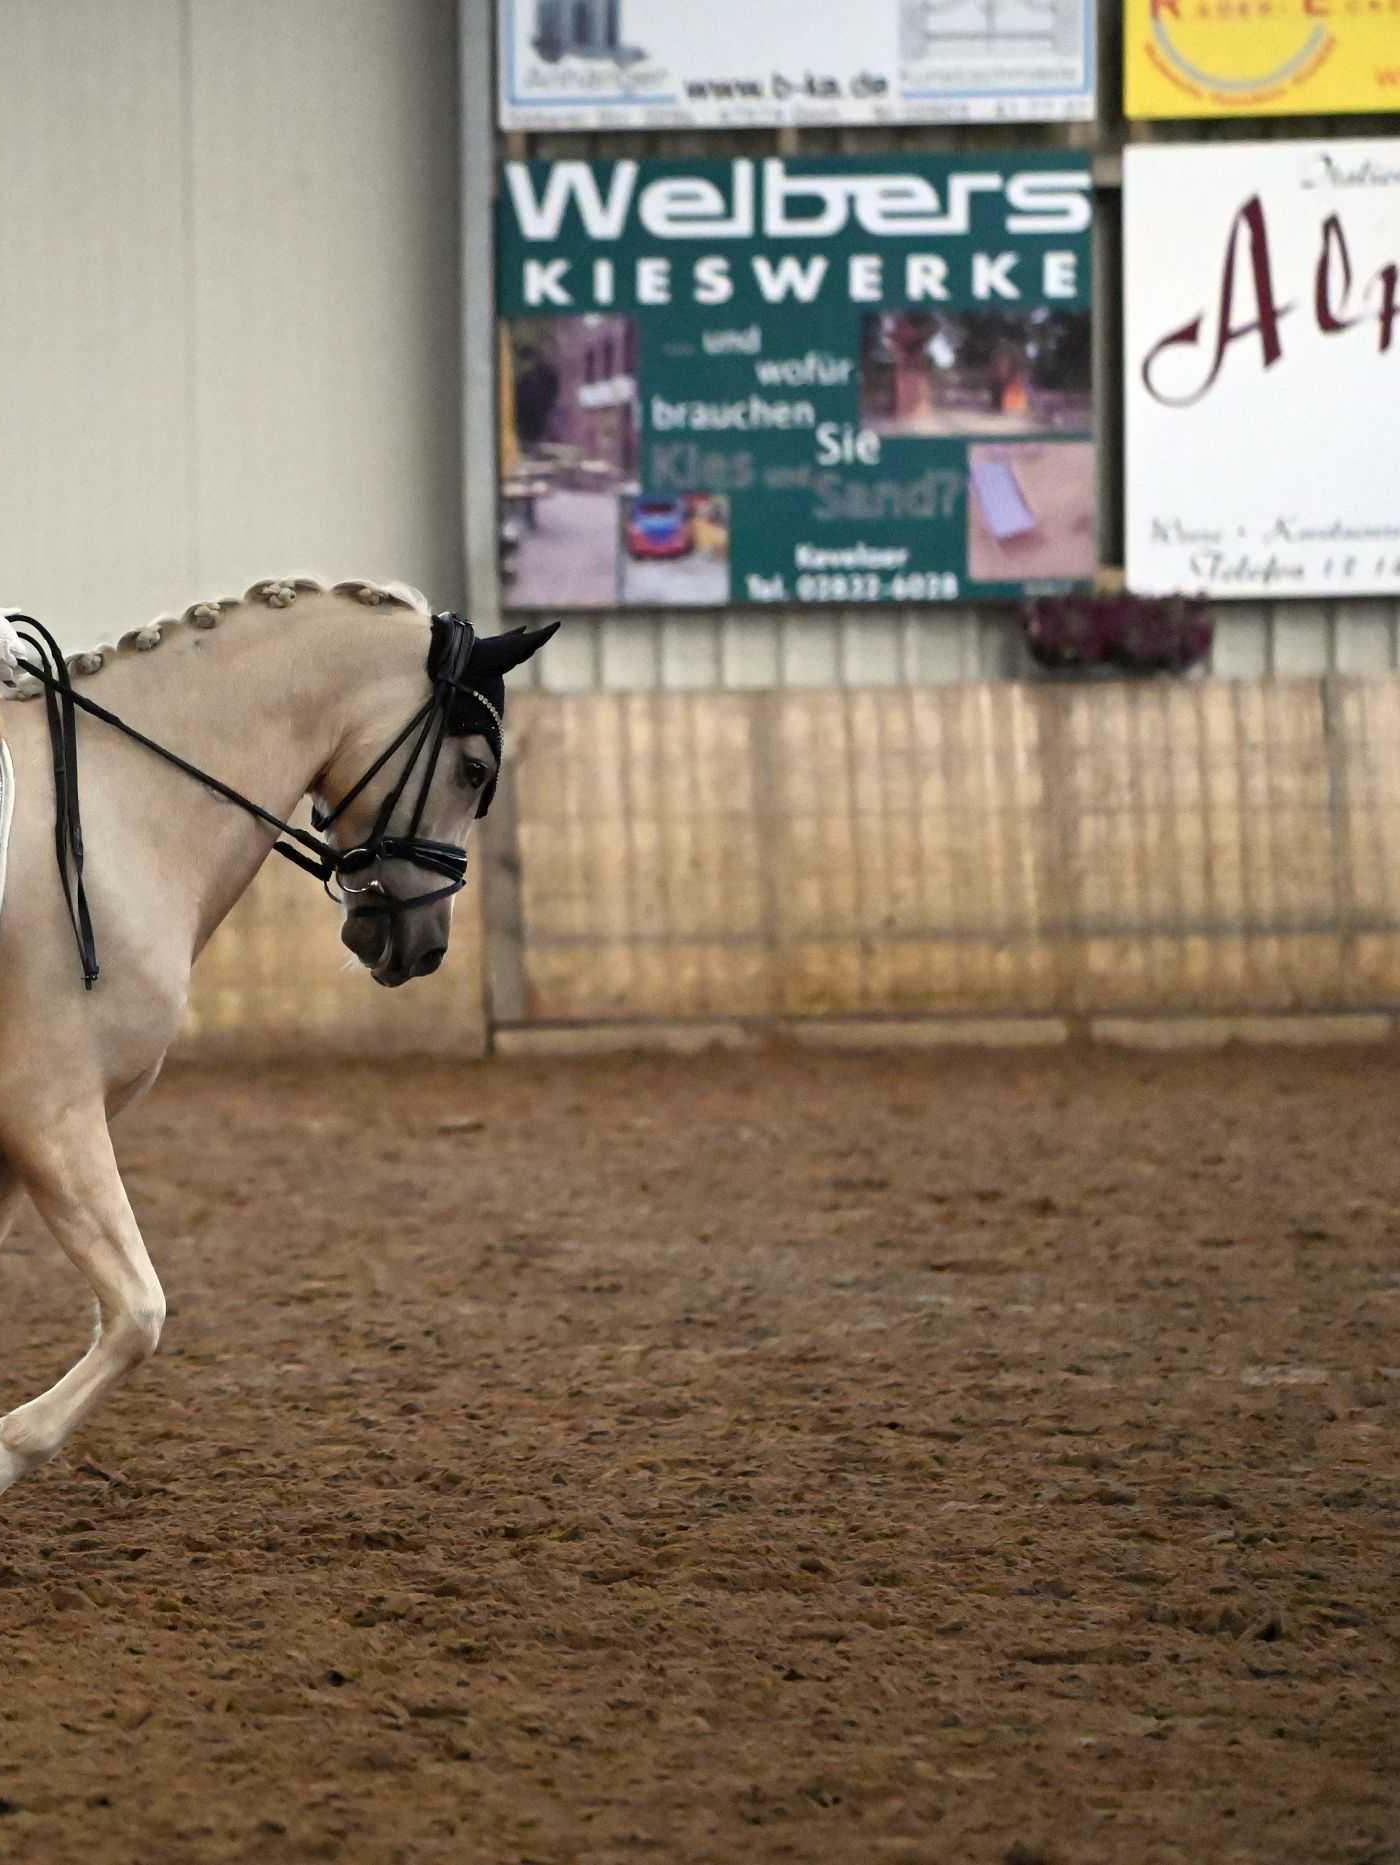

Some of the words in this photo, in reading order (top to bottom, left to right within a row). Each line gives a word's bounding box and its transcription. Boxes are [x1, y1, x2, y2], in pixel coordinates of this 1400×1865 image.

[504, 158, 1093, 241] Welbers
[522, 250, 1079, 304] KIESWERKE
[702, 324, 762, 356] und
[754, 350, 854, 386] wofür
[651, 394, 815, 431] brauchen
[814, 421, 881, 467] Sie
[649, 444, 754, 488] Kies
[812, 467, 961, 519] Sand?
